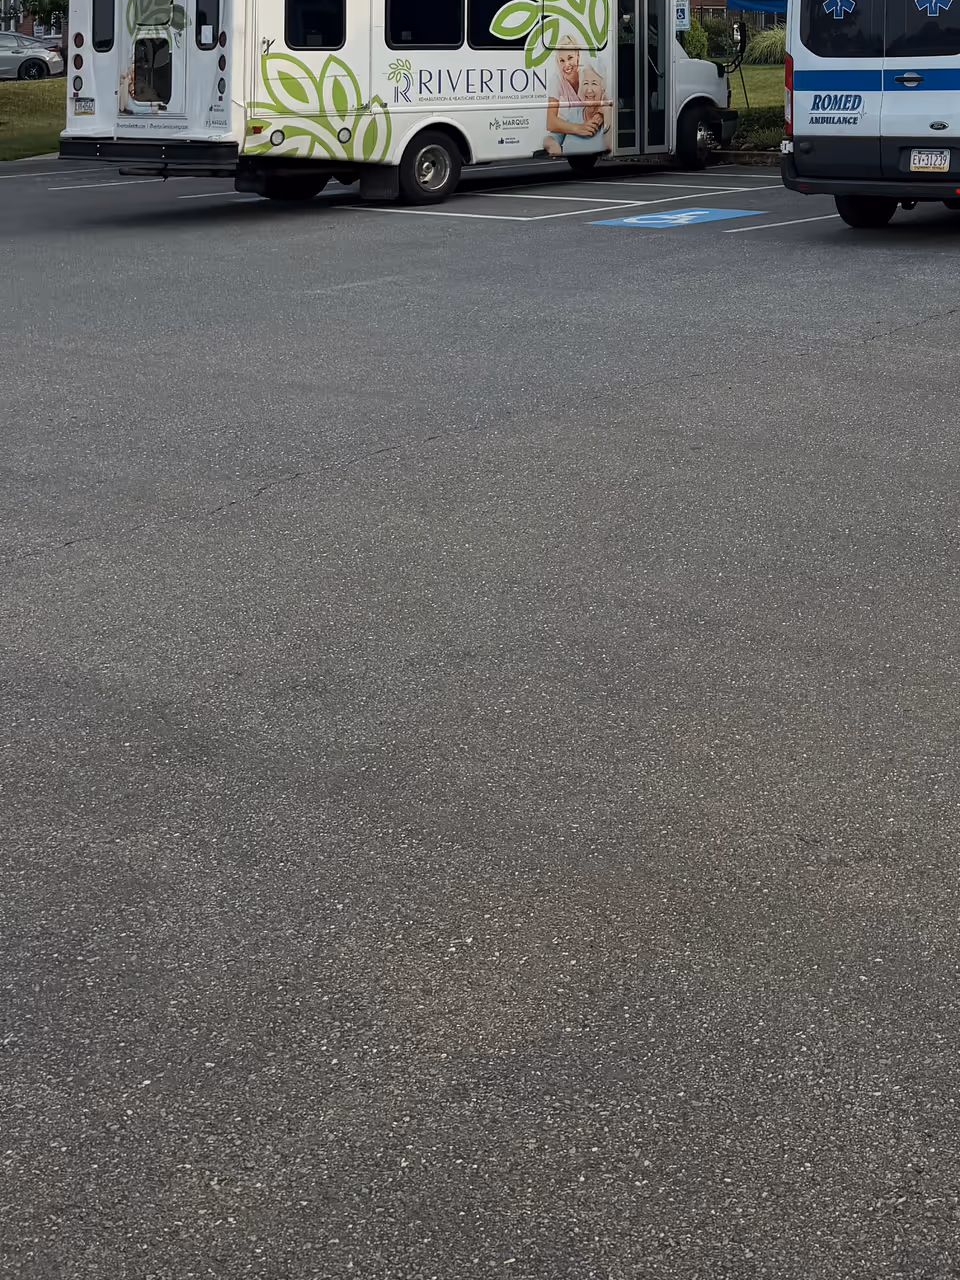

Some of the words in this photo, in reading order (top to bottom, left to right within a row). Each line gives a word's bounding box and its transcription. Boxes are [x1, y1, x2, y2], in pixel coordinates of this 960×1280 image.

[418, 68, 547, 95] RIVERTON
[810, 94, 862, 112] ROMED
[809, 116, 858, 125] AMBULANCE
